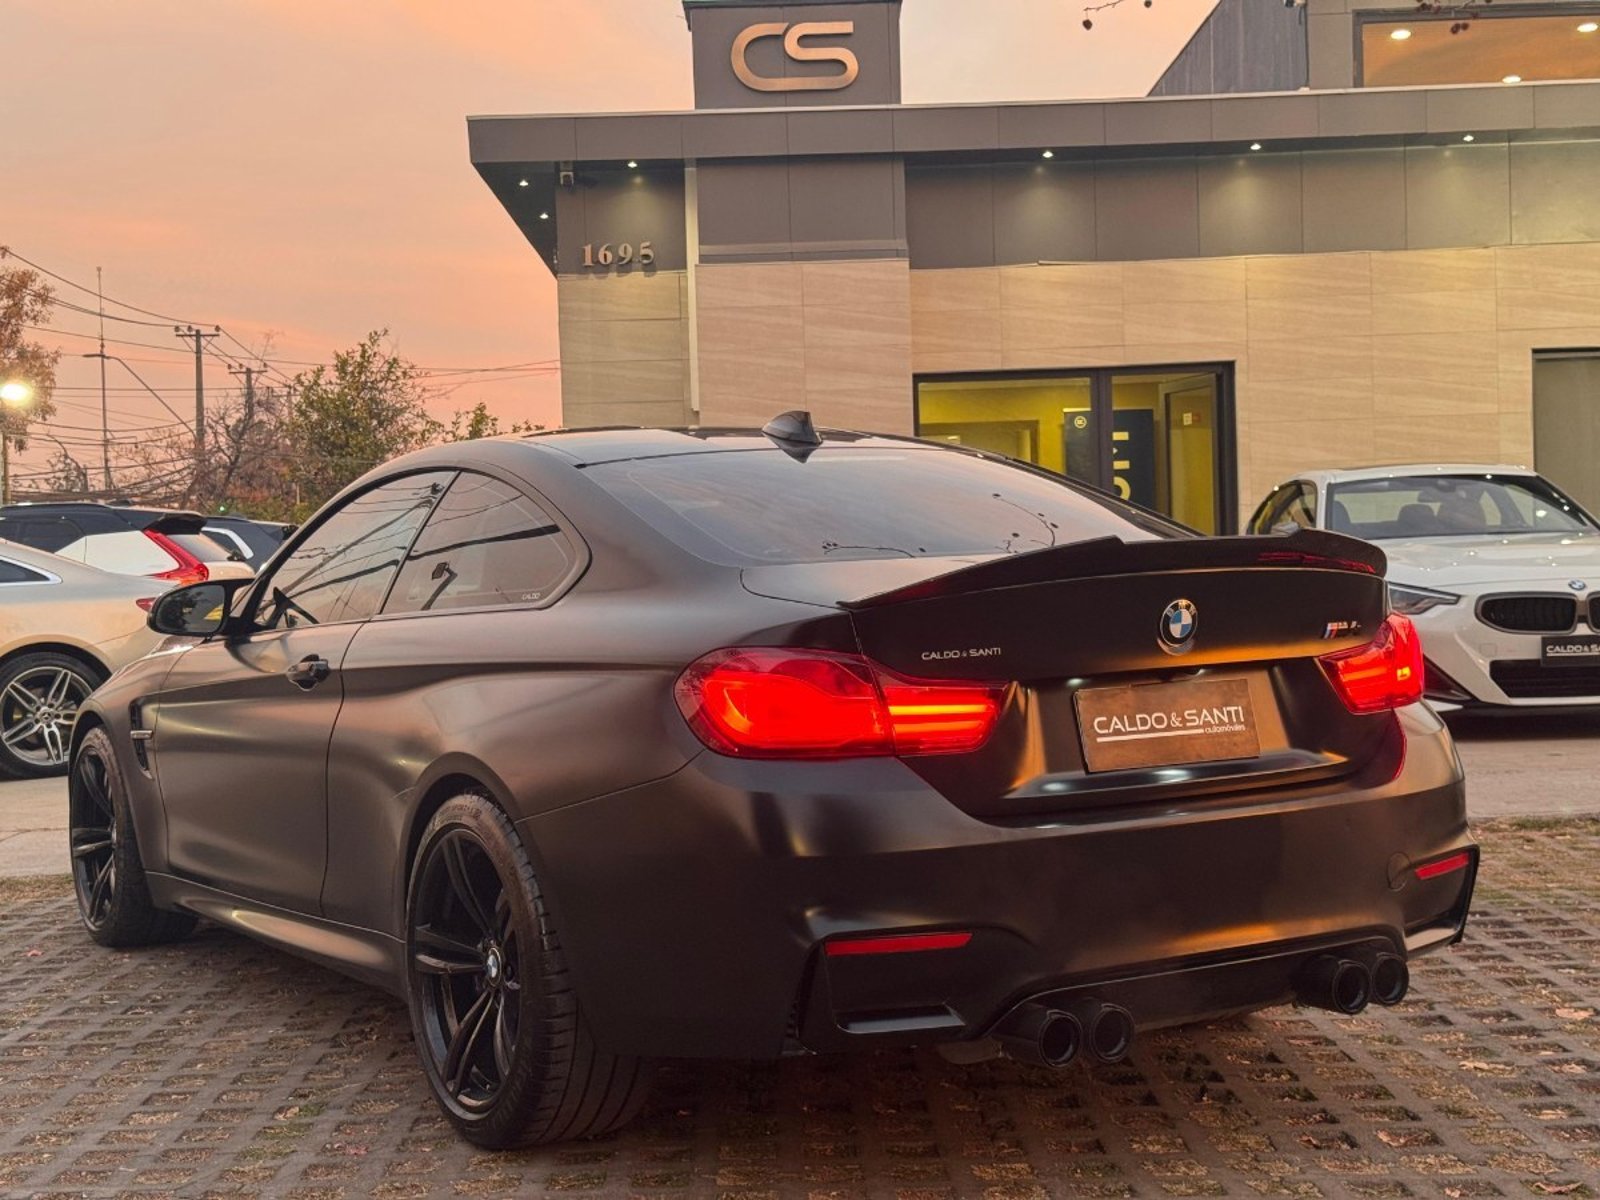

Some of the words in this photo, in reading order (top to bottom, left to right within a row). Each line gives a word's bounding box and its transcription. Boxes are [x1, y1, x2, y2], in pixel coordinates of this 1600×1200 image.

[730, 20, 860, 92] CS
[582, 241, 655, 267] 1695
[921, 650, 960, 660] CALDO
[969, 647, 1001, 657] SANTI
[1545, 645, 1582, 653] CALDO
[1093, 712, 1168, 734] CALDO
[1170, 712, 1183, 728] &
[1184, 705, 1245, 726] SANTI
